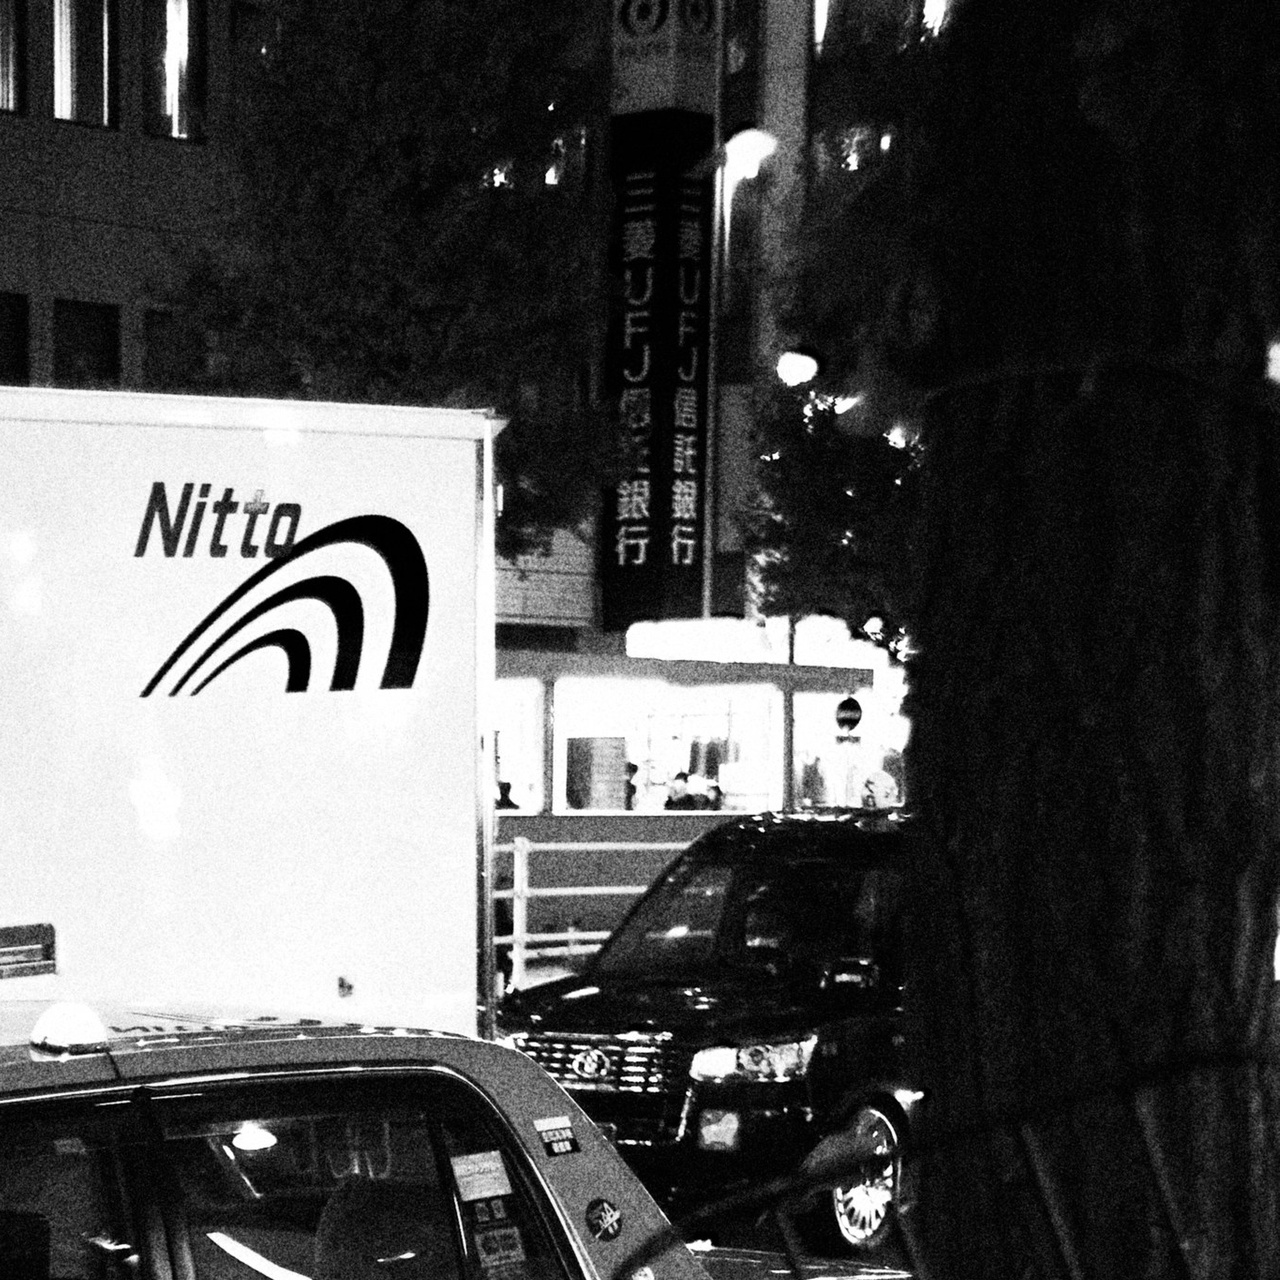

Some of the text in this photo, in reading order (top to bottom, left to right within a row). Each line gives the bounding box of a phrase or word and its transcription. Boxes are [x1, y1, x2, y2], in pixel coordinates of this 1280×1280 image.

[614, 170, 657, 568] 三菱UFJ信銀行
[133, 481, 302, 559] Nitto
